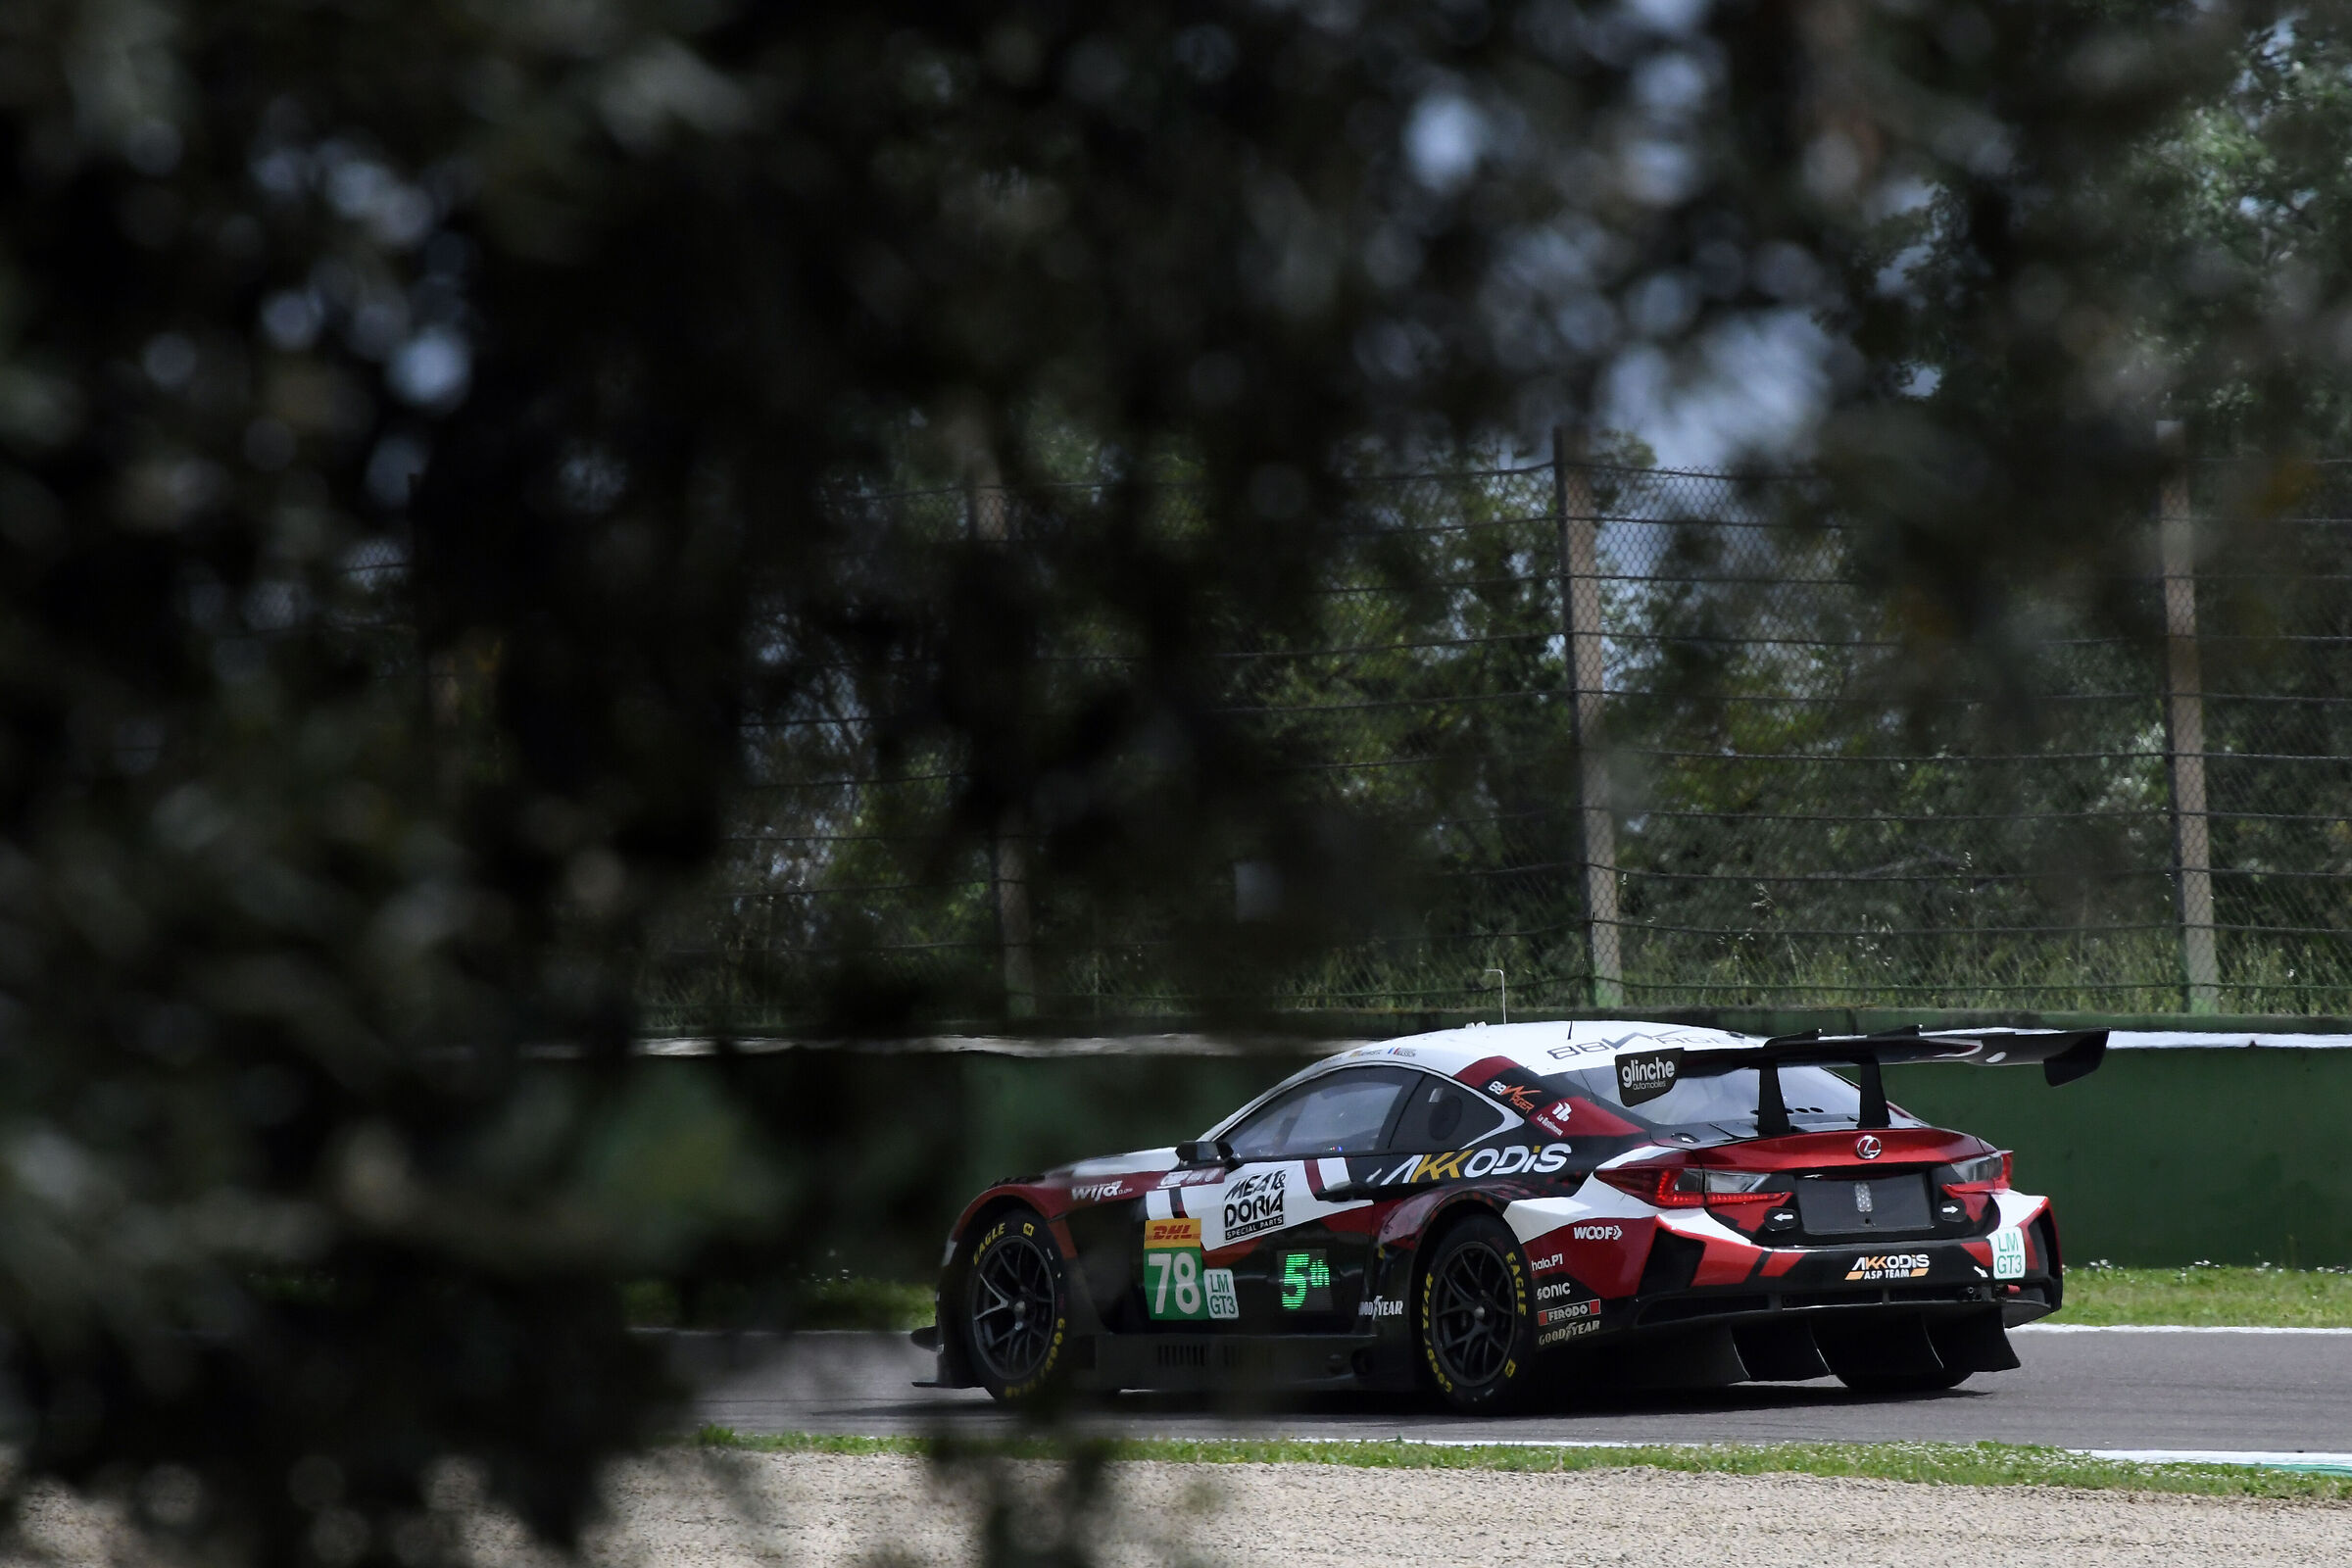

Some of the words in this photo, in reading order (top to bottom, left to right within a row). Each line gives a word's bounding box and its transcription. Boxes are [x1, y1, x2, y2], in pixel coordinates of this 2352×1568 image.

[1622, 1057, 1676, 1089] glinche
[1633, 1079, 1667, 1091] automobiles
[1224, 1189, 1285, 1228] DORIA
[1152, 1224, 1193, 1241] DHL
[1226, 1224, 1256, 1239] SPECIAL
[1259, 1216, 1283, 1229] PARTS
[973, 1223, 1006, 1266] EAGLE
[1997, 1232, 2019, 1252] LM
[1531, 1253, 1564, 1272] halo.P1
[1996, 1254, 2023, 1274] GT3
[1148, 1251, 1201, 1315] 78
[1209, 1274, 1230, 1294] LM
[1506, 1251, 1527, 1317] EAGLE
[1863, 1270, 1883, 1281] ASP
[1885, 1268, 1910, 1279] TEAM
[1209, 1295, 1236, 1315] GT3
[1548, 1304, 1589, 1322] FERODO
[1539, 1320, 1600, 1346] GOODYEAR
